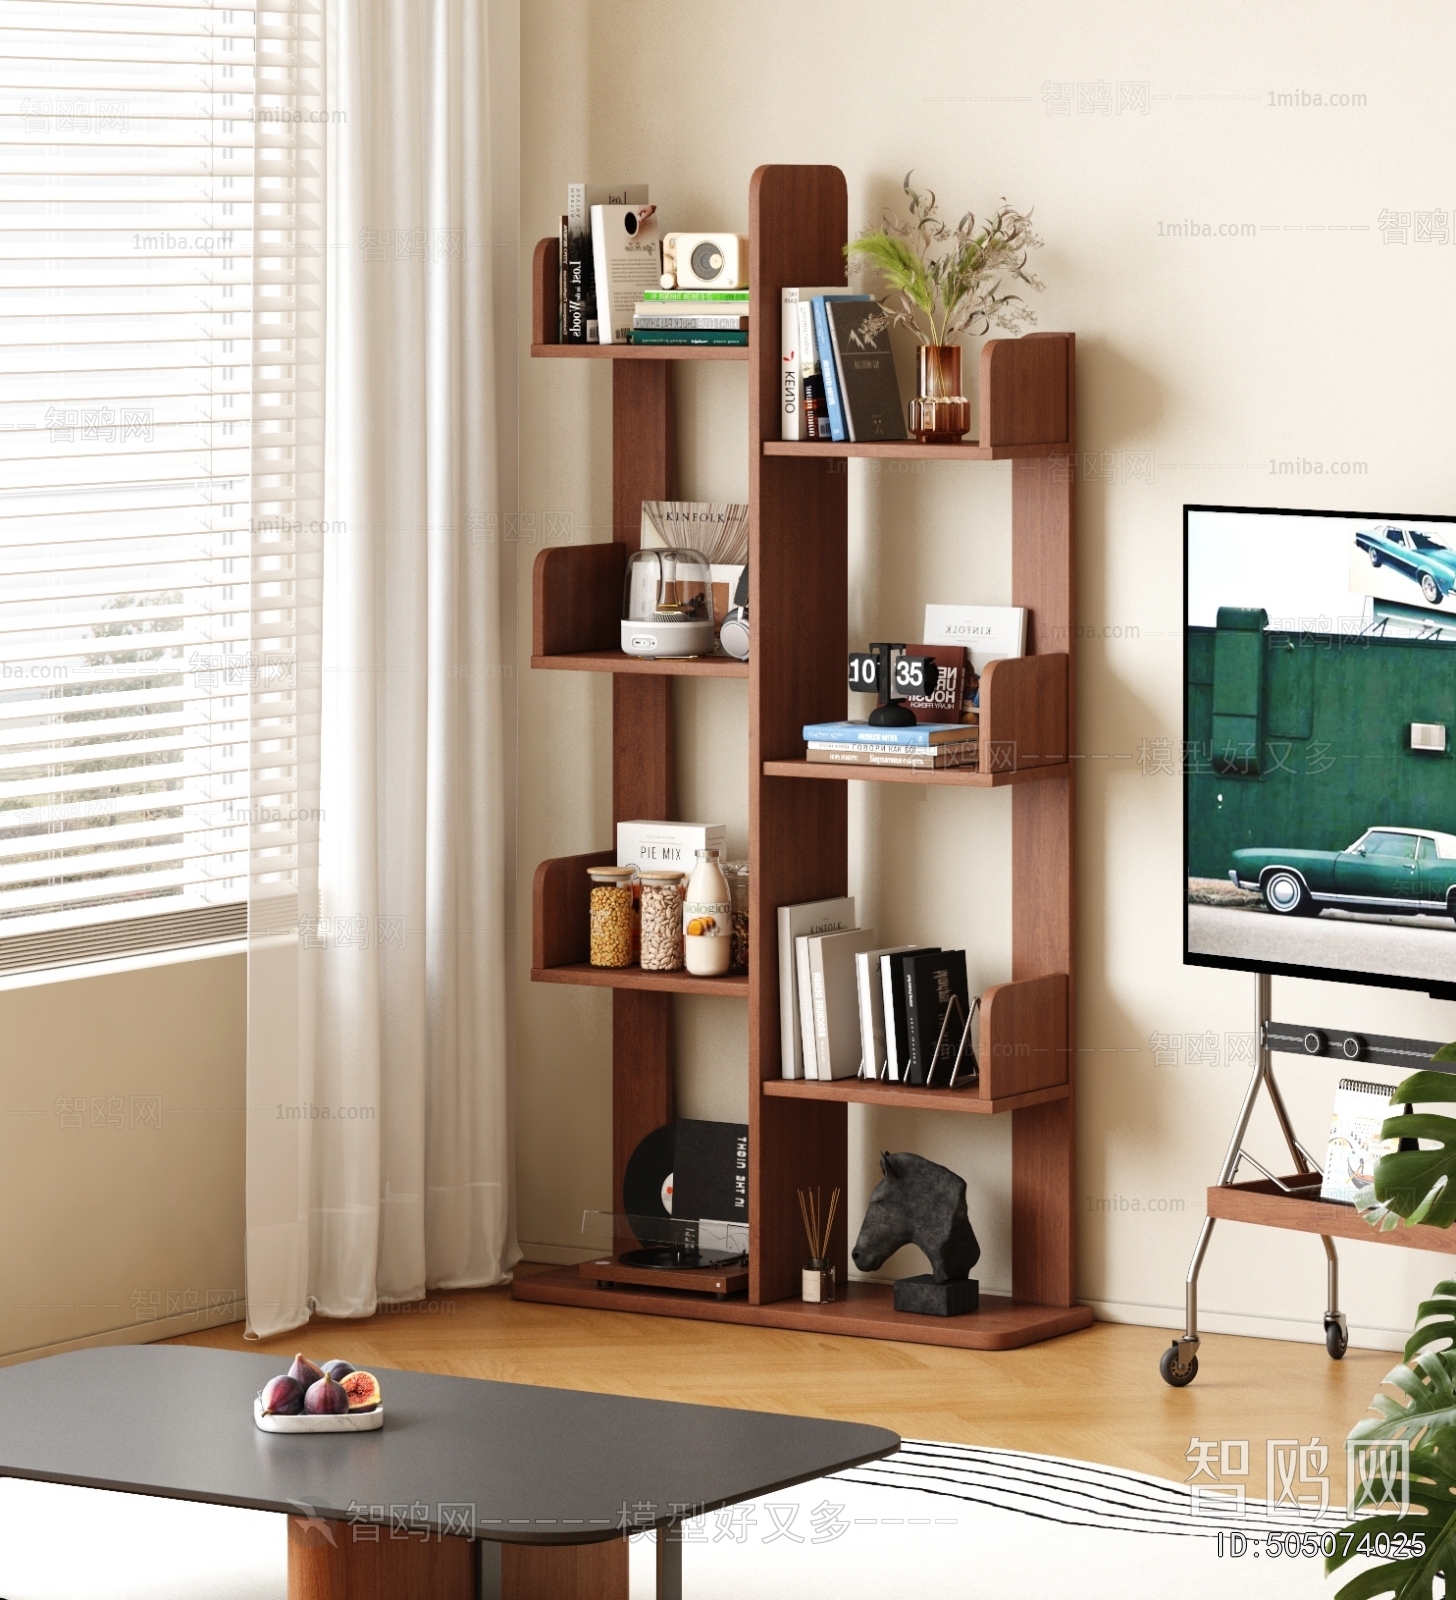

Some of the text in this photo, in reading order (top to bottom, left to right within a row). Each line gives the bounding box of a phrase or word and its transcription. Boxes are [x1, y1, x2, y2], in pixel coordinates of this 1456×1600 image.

[666, 512, 725, 522] KINFOLK
[850, 658, 876, 684] 10
[896, 660, 922, 686] 35
[852, 744, 886, 752] ГОВОРИ
[640, 846, 682, 861] PIE MIX
[810, 922, 842, 934] KINFOLK
